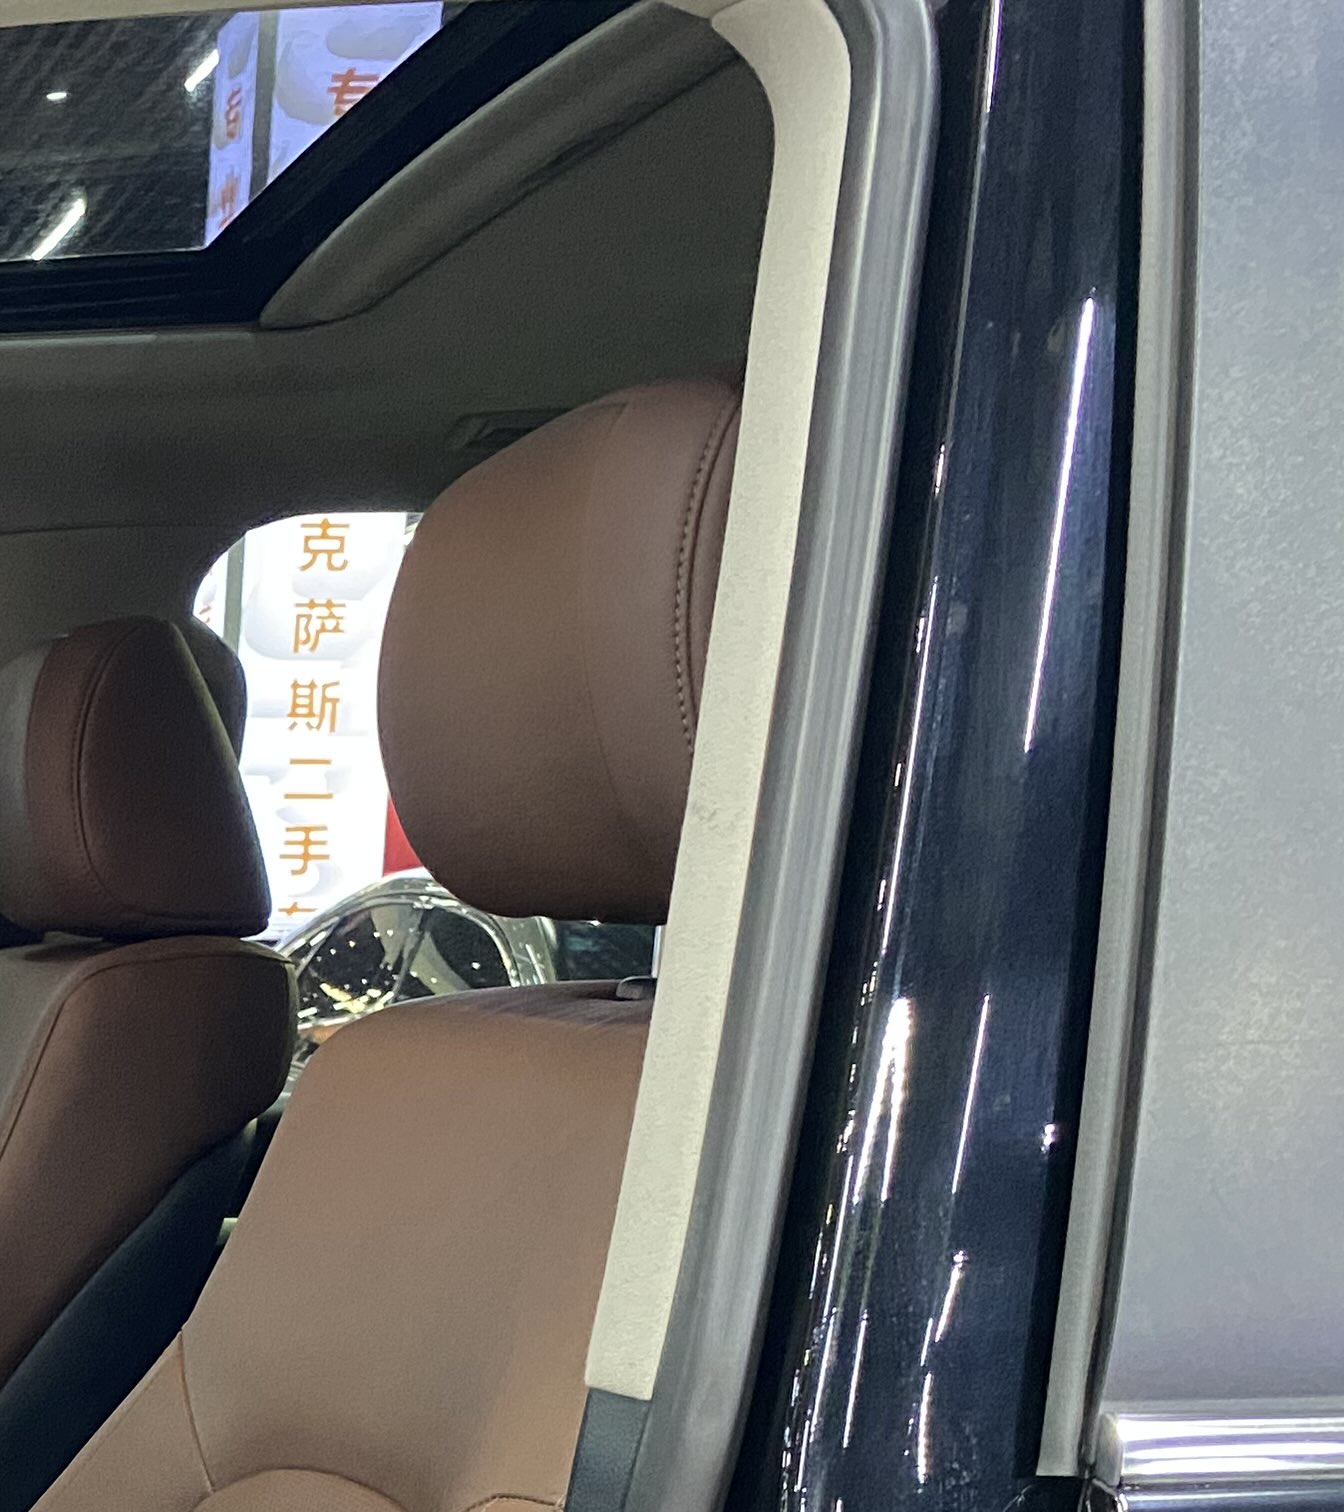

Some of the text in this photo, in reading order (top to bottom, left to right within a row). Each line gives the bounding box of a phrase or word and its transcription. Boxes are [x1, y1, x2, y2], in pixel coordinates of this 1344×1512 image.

[277, 518, 350, 917] 克萨斯二手
